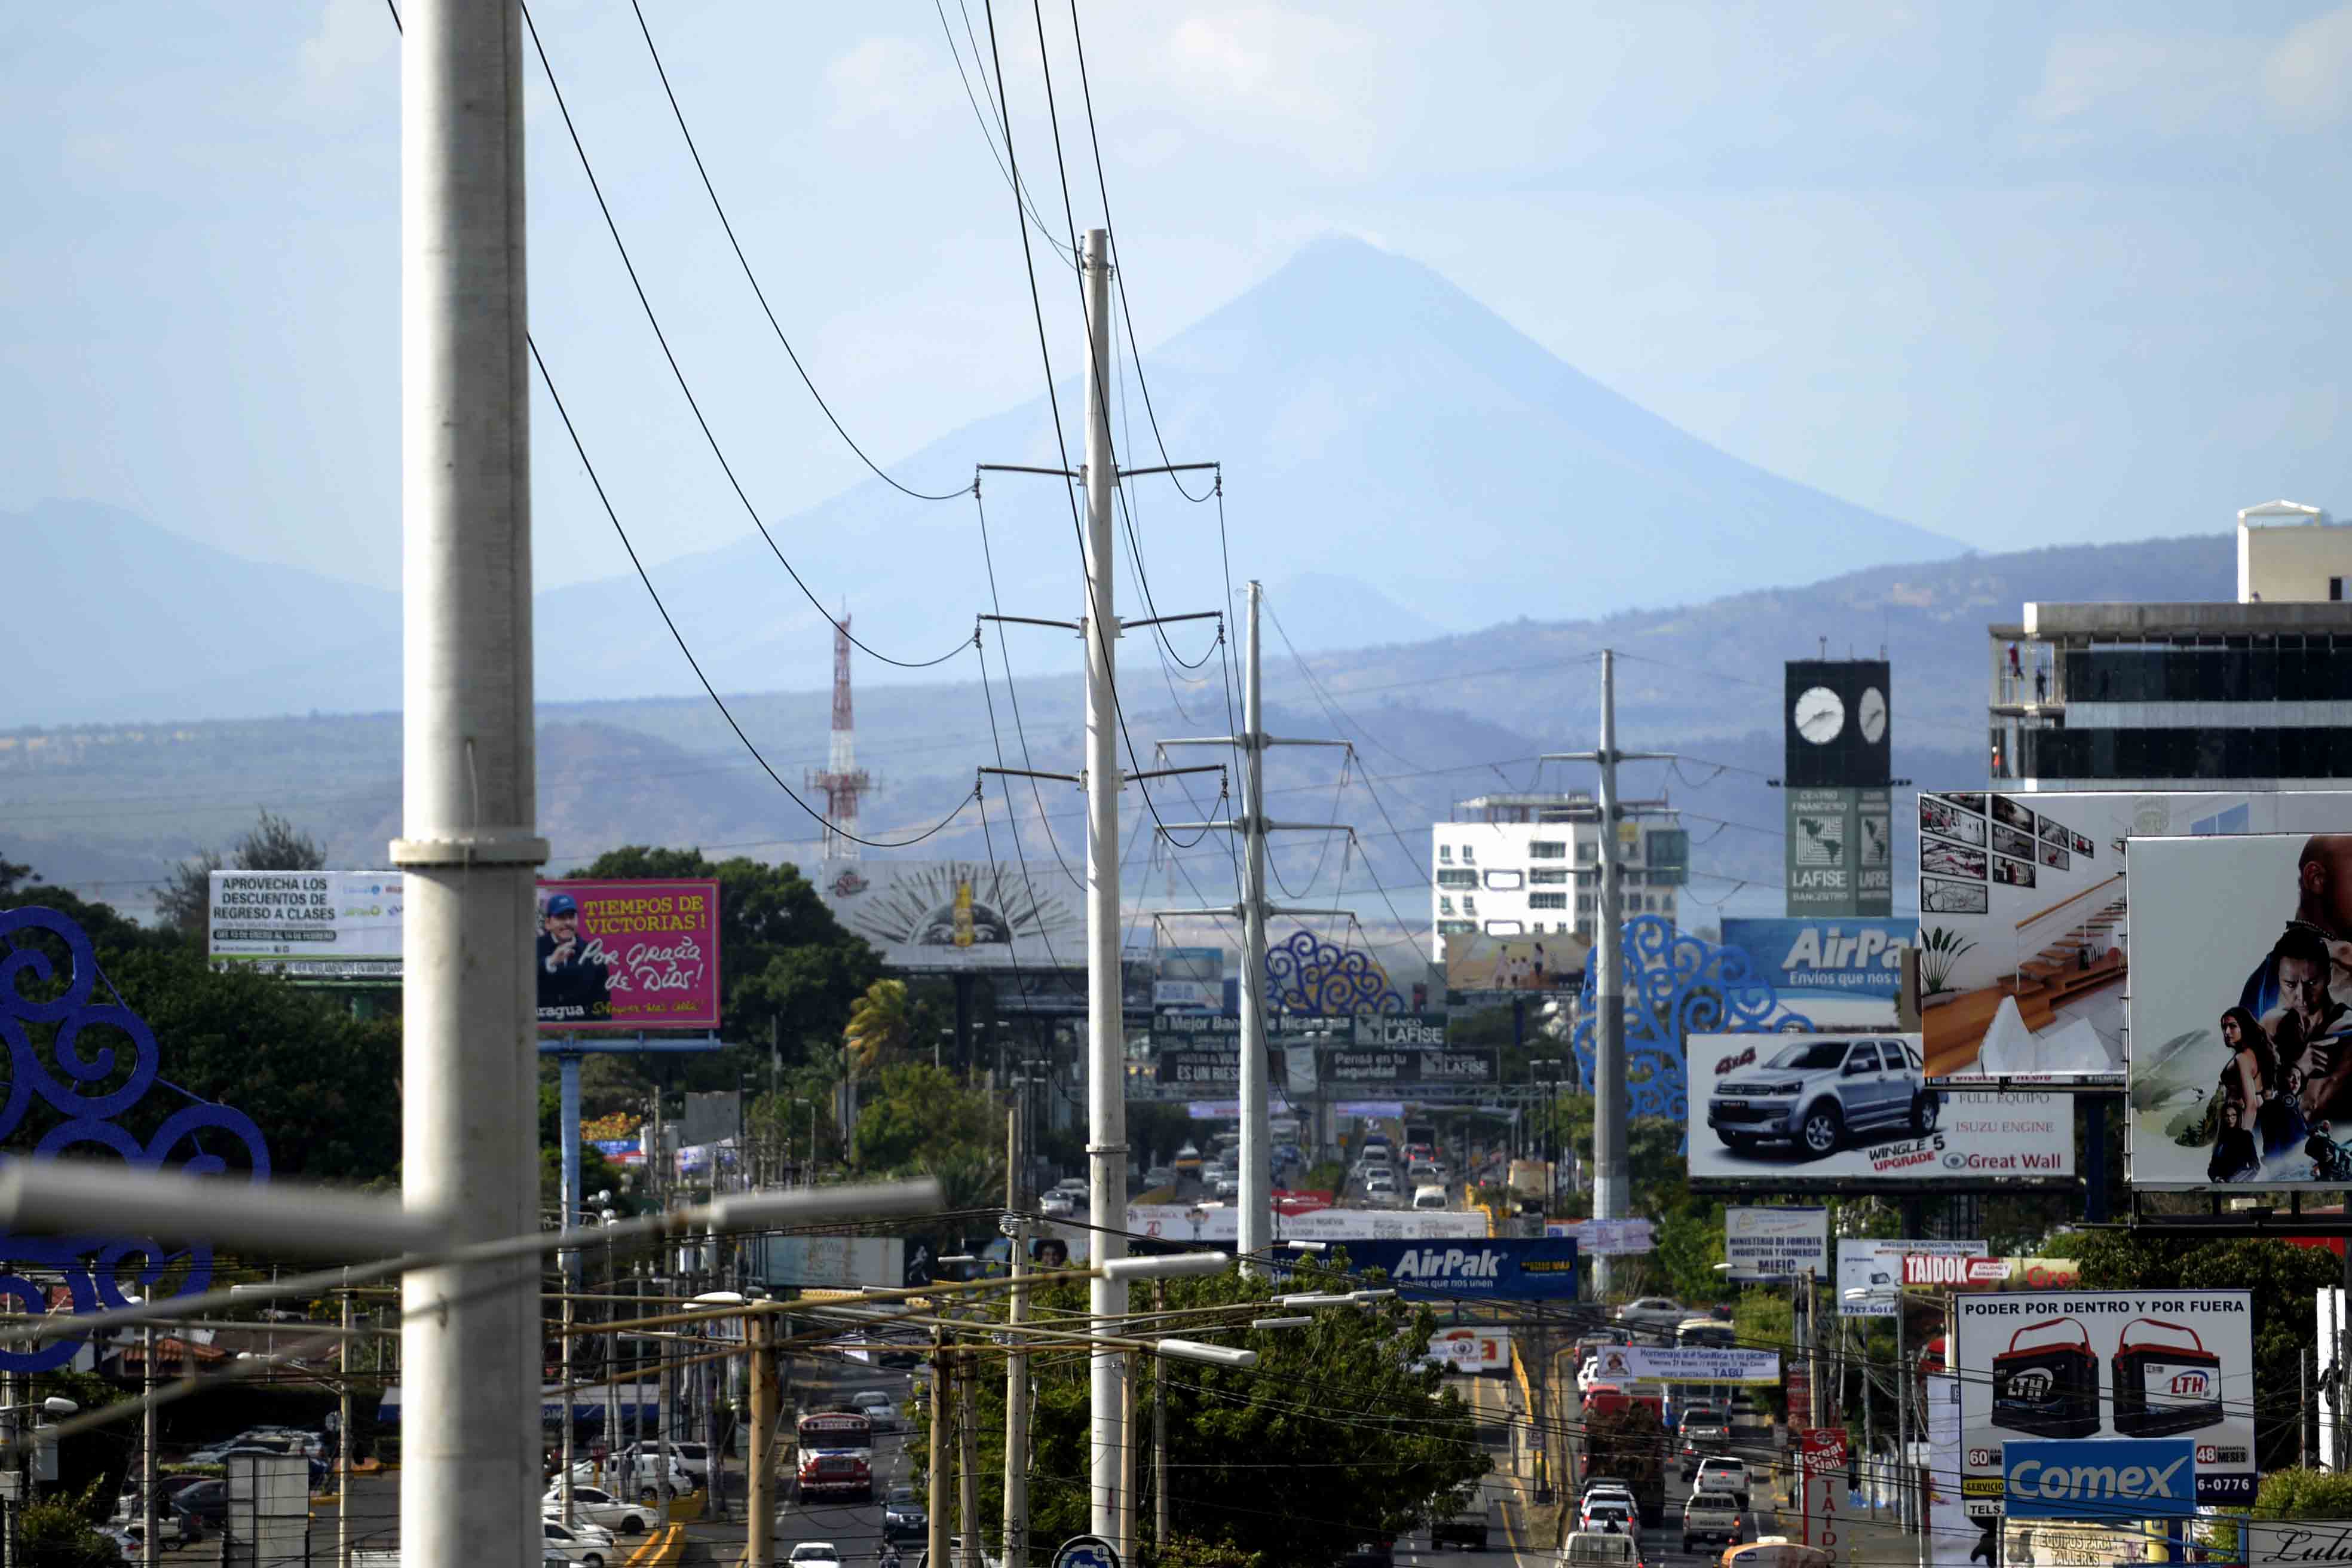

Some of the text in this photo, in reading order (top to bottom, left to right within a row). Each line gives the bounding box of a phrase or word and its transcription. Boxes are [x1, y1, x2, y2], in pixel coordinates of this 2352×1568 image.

[222, 877, 299, 890] APROVECHA
[302, 878, 327, 890] LOS
[1792, 870, 1848, 887] LAFISE
[222, 892, 327, 905] DESCUENTOS DE
[583, 895, 705, 918] TIEMPOS DE
[213, 907, 271, 919] REGRESO
[274, 907, 284, 920] A
[287, 908, 335, 920] CLASES
[1781, 927, 1921, 970] AirPa
[1838, 974, 1864, 987] que
[1867, 974, 1892, 985] nos
[537, 1004, 585, 1019] ragua
[1170, 1016, 1208, 1032] Mejor
[1212, 1016, 1241, 1029] Ban
[1384, 1027, 1444, 1043] LAFISE
[1376, 1054, 1391, 1064] en
[1393, 1053, 1407, 1064] tu
[1714, 1046, 1757, 1075] 4x4
[1177, 1065, 1192, 1080] ES
[1212, 1065, 1241, 1080] RIES
[1335, 1064, 1396, 1080] seguridad
[1444, 1061, 1489, 1074] LAFISE
[1959, 1092, 2050, 1105] FULL EQUIPO
[1955, 1120, 2054, 1133] ISUZU ENGINE
[1869, 1134, 1946, 1161] WINGLE 5
[1873, 1150, 1936, 1172] UPGRADE
[1967, 1153, 2061, 1169] Great Wall
[1729, 1237, 1774, 1245] MINISTERIO
[1775, 1237, 1785, 1245] DE
[1732, 1248, 1821, 1257] INDUSTRIA Y COMERCIO
[1392, 1248, 1500, 1278] AirPak
[1757, 1258, 1796, 1273] MIFIC
[1906, 1257, 1968, 1284] TAIDOK
[1430, 1280, 1447, 1290] que
[1451, 1279, 1466, 1288] nos
[1469, 1280, 1493, 1288] unen
[2028, 1266, 2082, 1288] Gre
[1964, 1300, 2245, 1316] PODER POR DENTRO Y POR FUERA
[2007, 1376, 2044, 1396] LTH
[2170, 1376, 2205, 1394] LTH
[1805, 1441, 1844, 1465] Great
[1969, 1450, 1988, 1465] 60
[2197, 1447, 2215, 1462] 48
[2218, 1451, 2246, 1463] MESES
[2008, 1455, 2190, 1500] Comex
[2197, 1478, 2250, 1491] 6-0776
[1966, 1481, 2004, 1492] SERVICIO
[1821, 1479, 1838, 1563] TAIDO
[2039, 1531, 2112, 1550] EQUIPOS PARA
[2050, 1550, 2101, 1567] TALLERES
